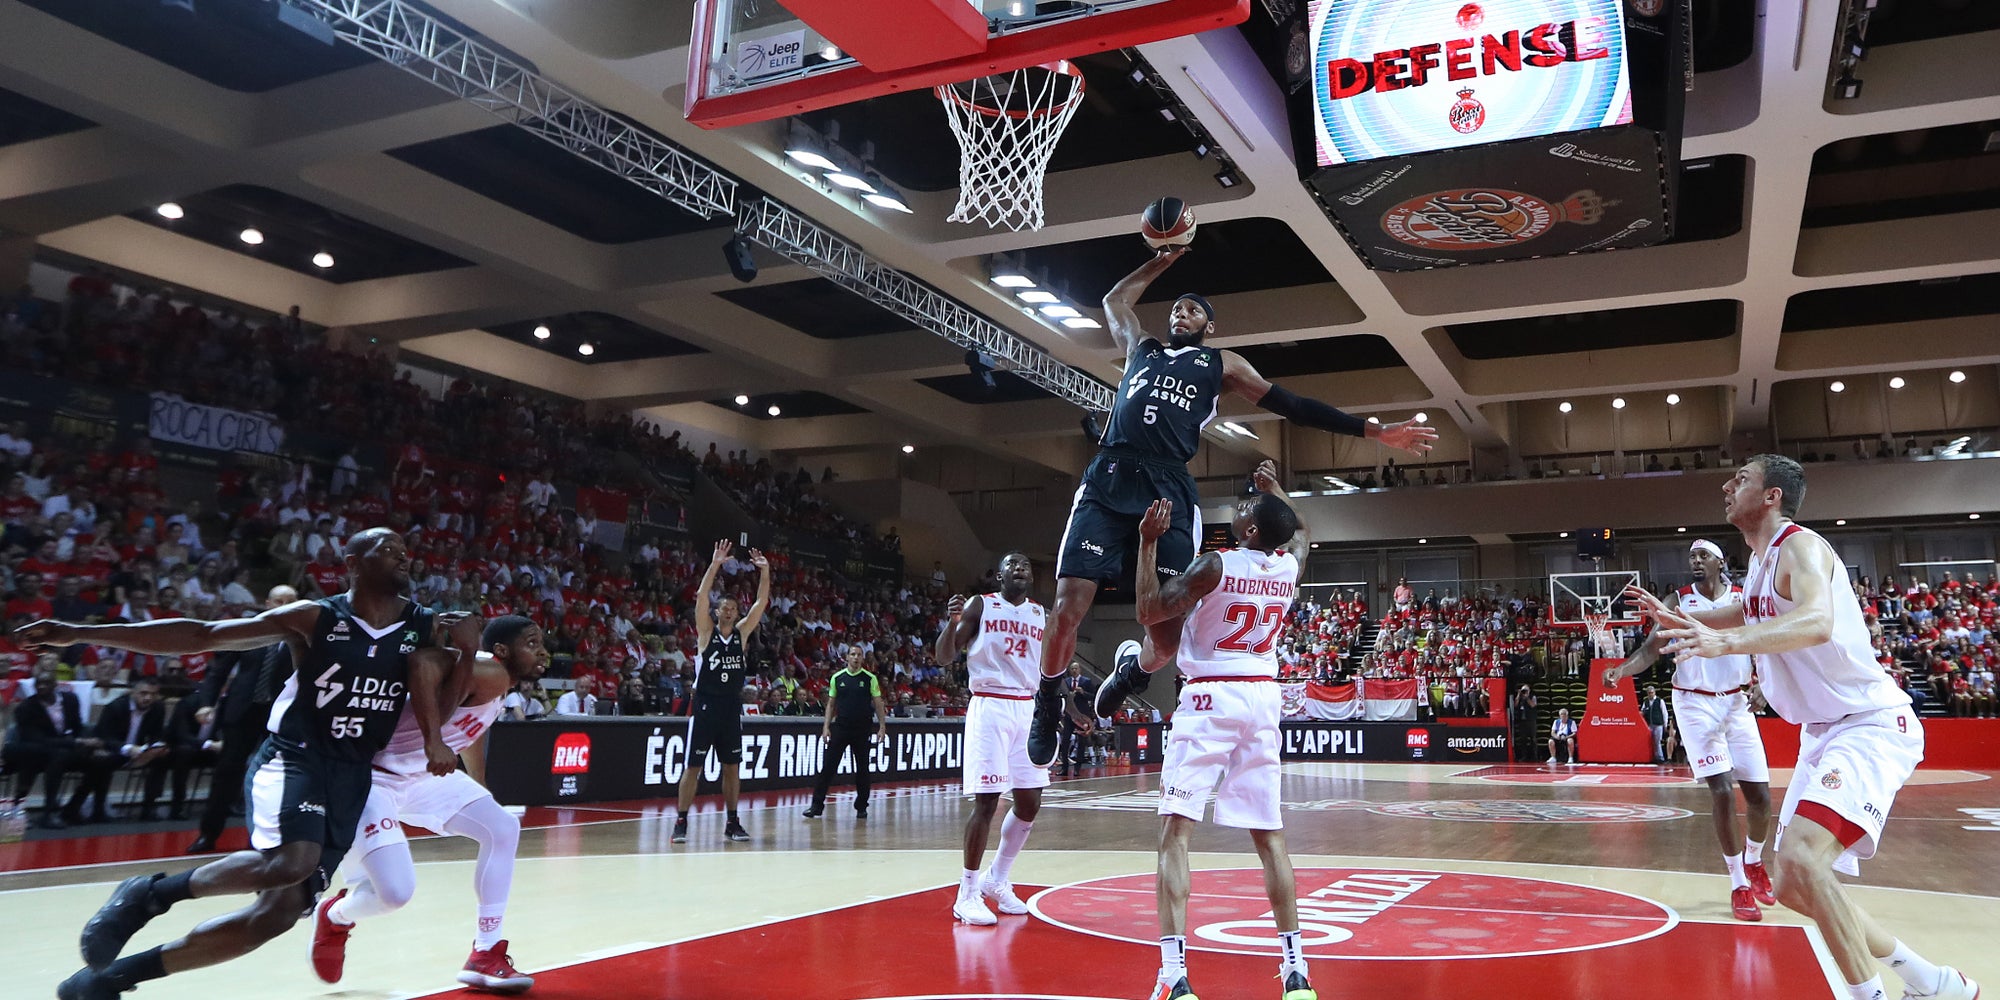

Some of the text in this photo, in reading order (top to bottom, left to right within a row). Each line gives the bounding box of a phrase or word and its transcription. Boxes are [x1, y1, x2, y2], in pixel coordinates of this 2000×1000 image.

[768, 41, 800, 56] Jeep
[1328, 16, 1609, 100] DEFENSE
[1153, 375, 1198, 399] LDLC
[1149, 388, 1191, 412] ASVEL
[151, 397, 211, 446] ROCA
[1143, 404, 1159, 425] 5
[1603, 528, 1611, 540] 3
[1222, 576, 1294, 598] ROBINSON
[984, 619, 1045, 642] MONACO
[1214, 601, 1285, 656] 22
[1004, 637, 1028, 658] 24
[721, 655, 741, 664] LDLC
[351, 676, 404, 697] LDLC
[720, 672, 729, 683] 9
[346, 696, 395, 712] ASVEL
[1192, 694, 1213, 711] 22
[1599, 692, 1624, 704] Jeep
[330, 716, 366, 739] 55
[1896, 715, 1907, 733] 9
[1286, 729, 1364, 754] L'APPLI
[1407, 734, 1428, 745] RMC
[1447, 735, 1506, 748] amazon.fr
[554, 745, 589, 768] RMC
[896, 732, 962, 772] L'APPLI
[1193, 873, 1442, 947] OREZZA
